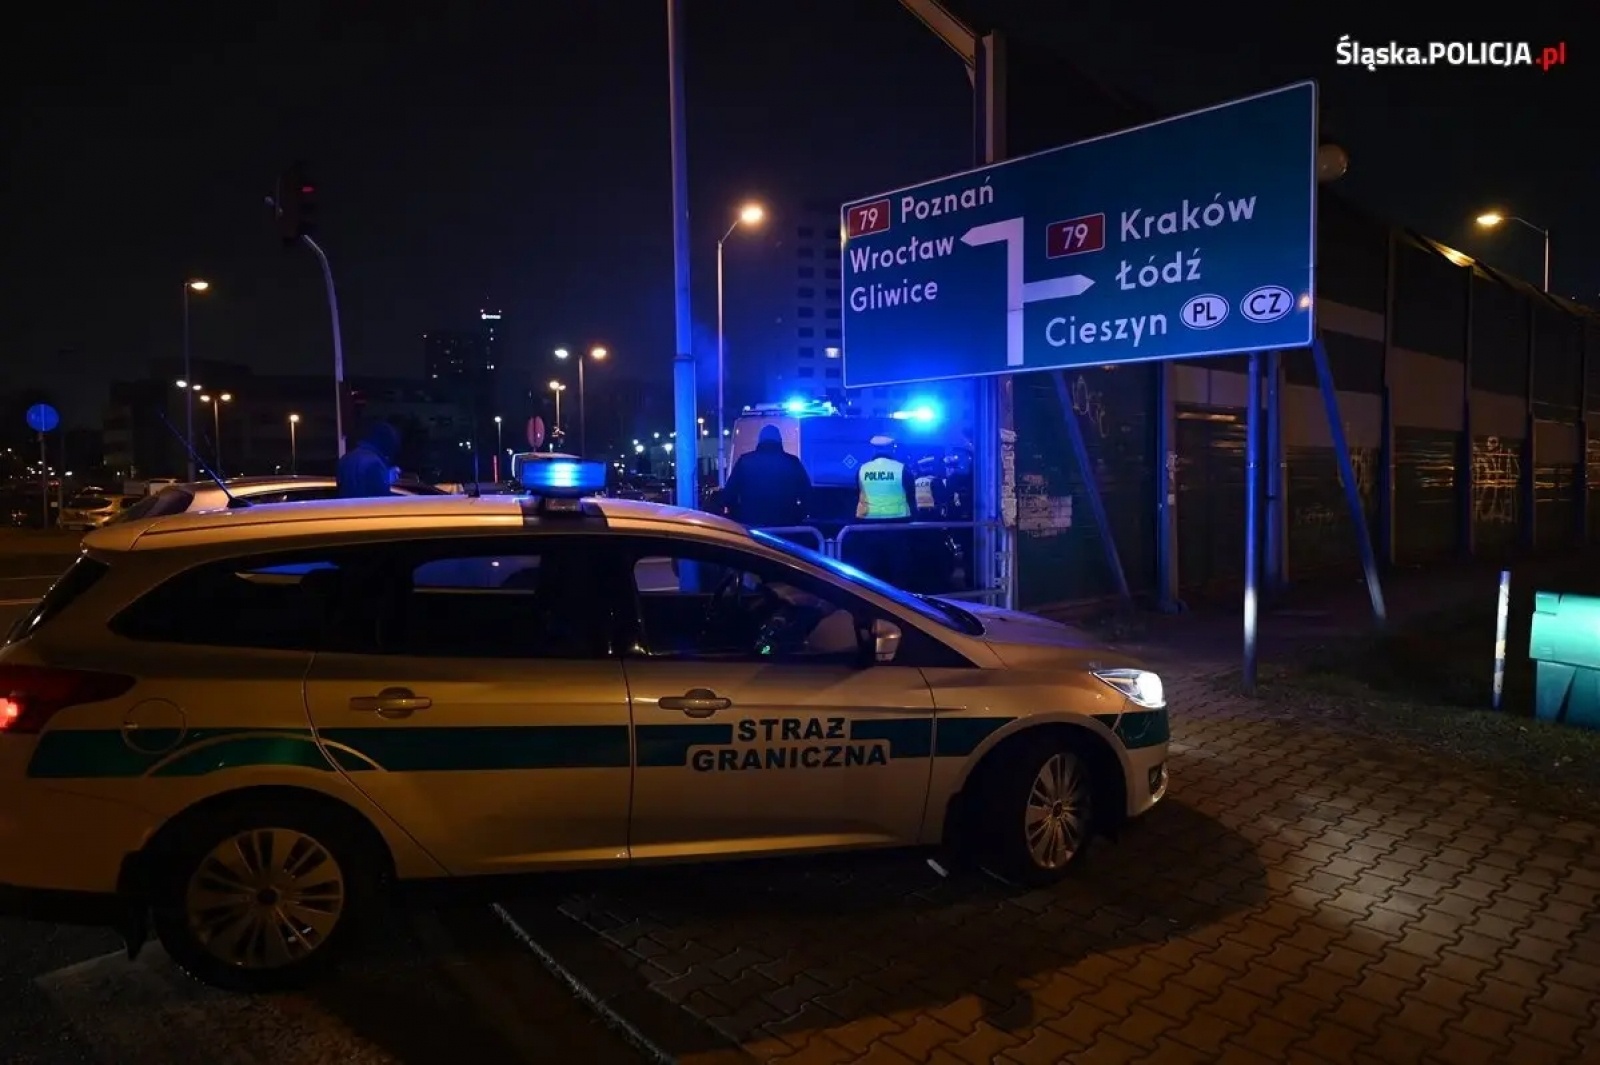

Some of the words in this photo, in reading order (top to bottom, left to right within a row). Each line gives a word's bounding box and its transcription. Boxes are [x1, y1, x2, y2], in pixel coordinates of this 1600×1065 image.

[859, 208, 878, 231] 79
[901, 176, 994, 223] Poznań
[1062, 223, 1088, 249] 79
[1120, 192, 1257, 242] Kraków
[850, 236, 954, 273] Wrocław
[1115, 248, 1201, 290] Łódź
[850, 279, 938, 312] Gliwice
[1045, 314, 1167, 347] Cieszyn
[1192, 302, 1217, 322] PL
[1249, 293, 1281, 315] CZ
[864, 471, 895, 481] POLICJA
[692, 745, 887, 772] GRANICZNA
